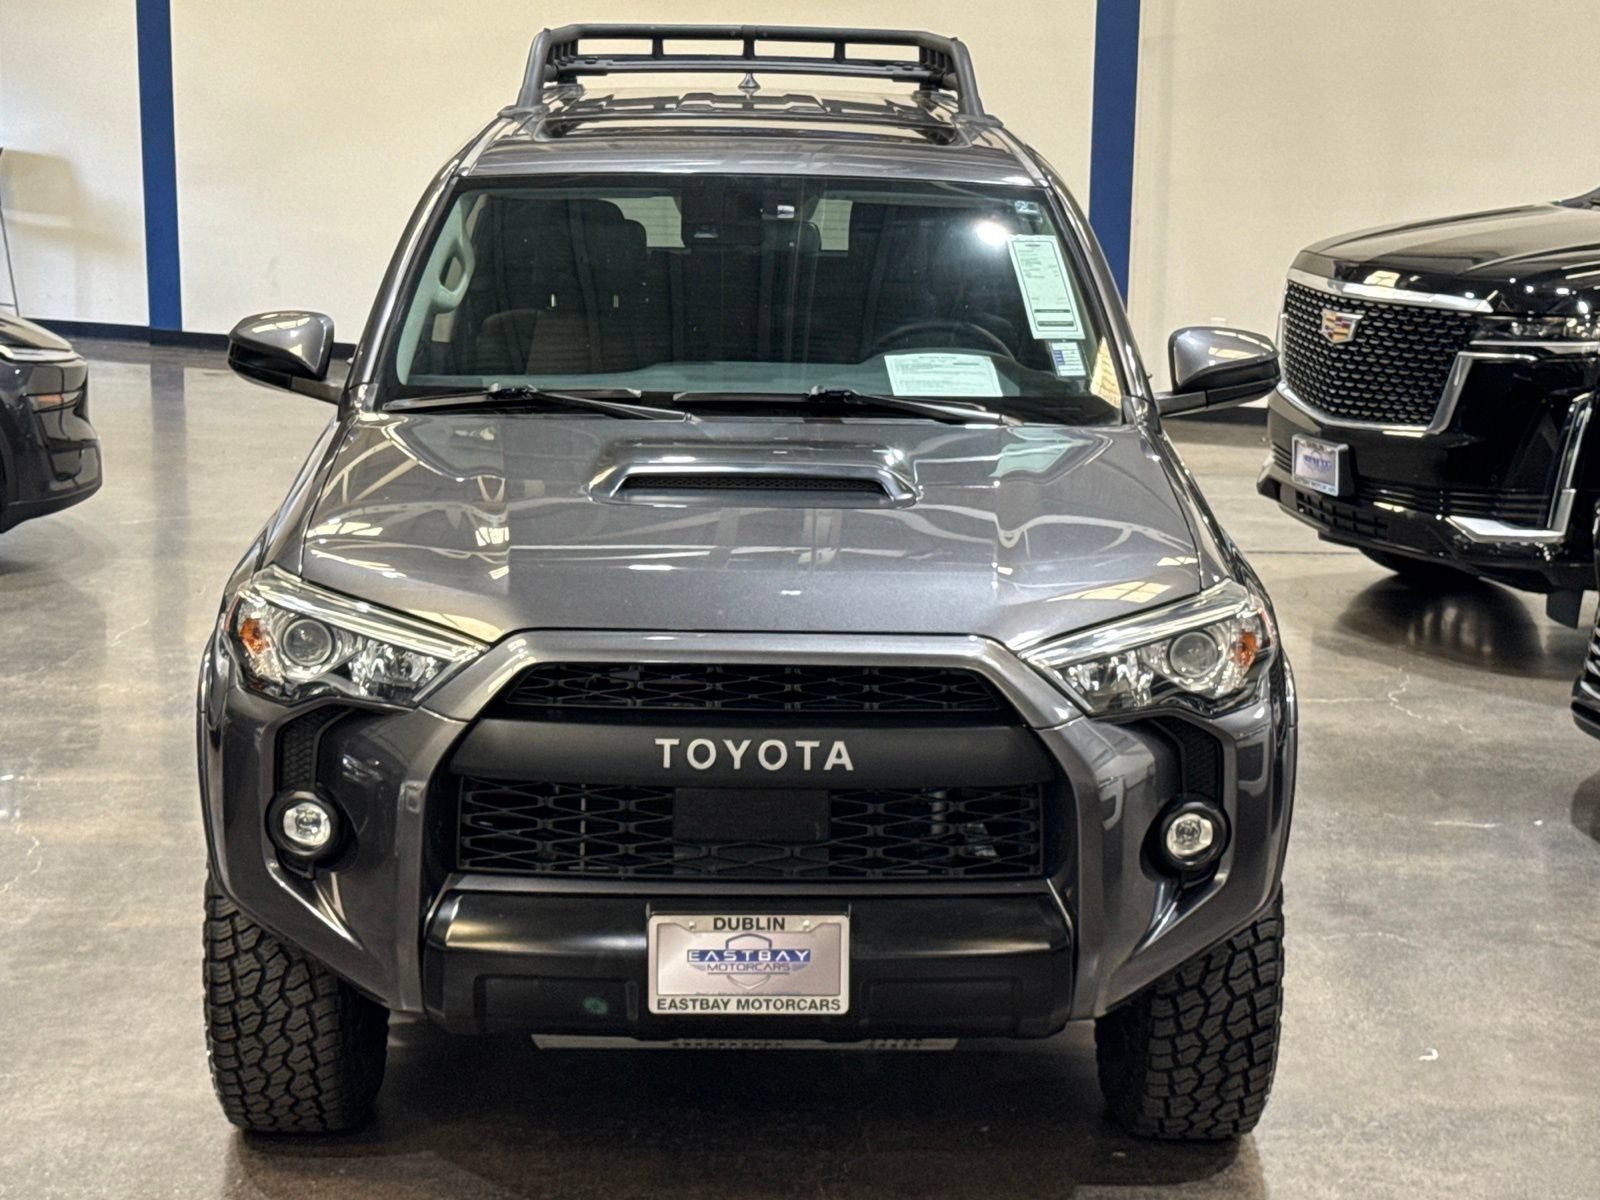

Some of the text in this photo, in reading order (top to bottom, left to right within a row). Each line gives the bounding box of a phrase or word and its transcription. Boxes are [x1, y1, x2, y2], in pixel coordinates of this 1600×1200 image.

[655, 738, 854, 771] TOYOTA
[713, 917, 786, 931] DUBLIN
[688, 950, 810, 962] EASTBAY
[707, 963, 790, 972] MOTORCARS
[657, 999, 841, 1011] EASTBAY MOTORCARS
